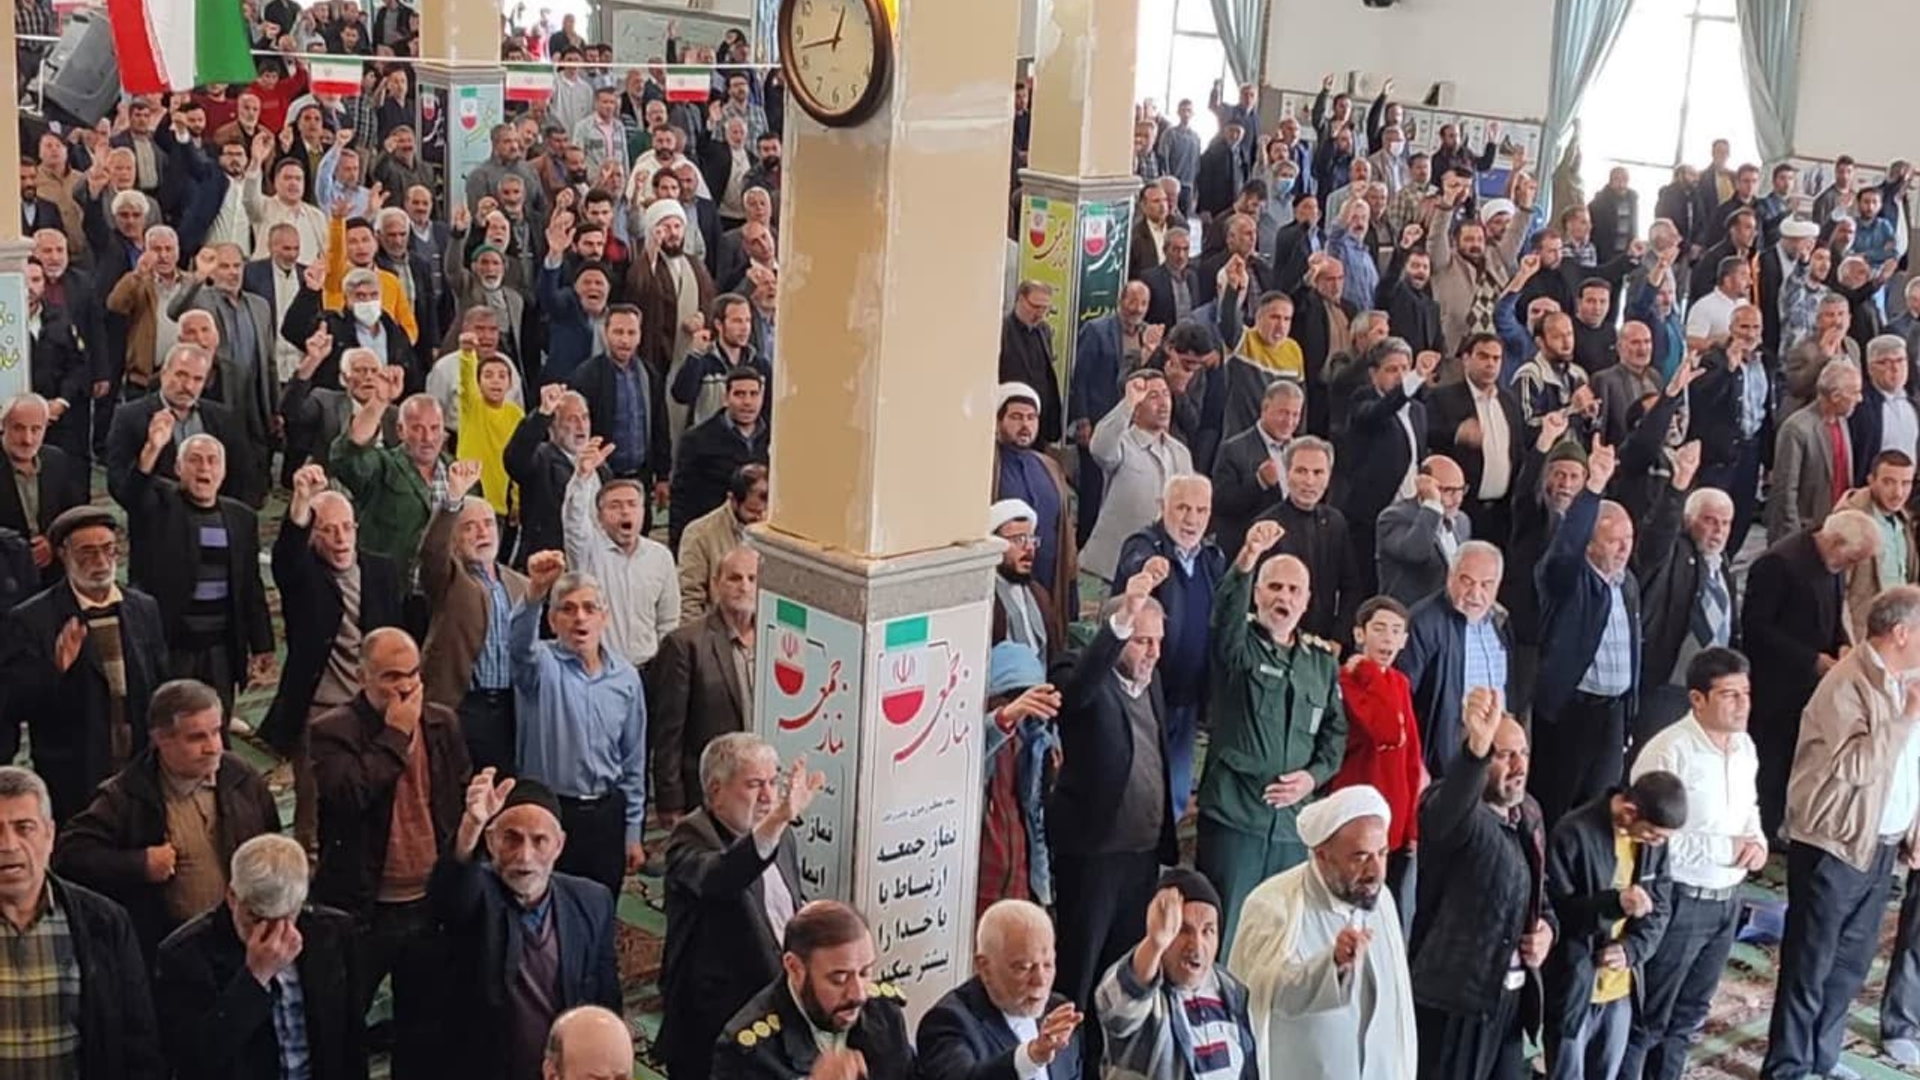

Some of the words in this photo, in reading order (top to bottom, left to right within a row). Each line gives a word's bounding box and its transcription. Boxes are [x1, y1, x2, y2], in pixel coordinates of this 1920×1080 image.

[832, 87, 840, 104] 6
[807, 815, 833, 843] نماز
[930, 820, 957, 858] نماز
[877, 838, 925, 862] جمعه
[802, 857, 826, 893] ایما
[893, 864, 948, 899] ارتباط
[879, 881, 888, 910] با
[896, 908, 933, 939] خدا
[938, 905, 947, 933] با
[878, 922, 891, 952] را
[916, 949, 949, 983] بیشتر
